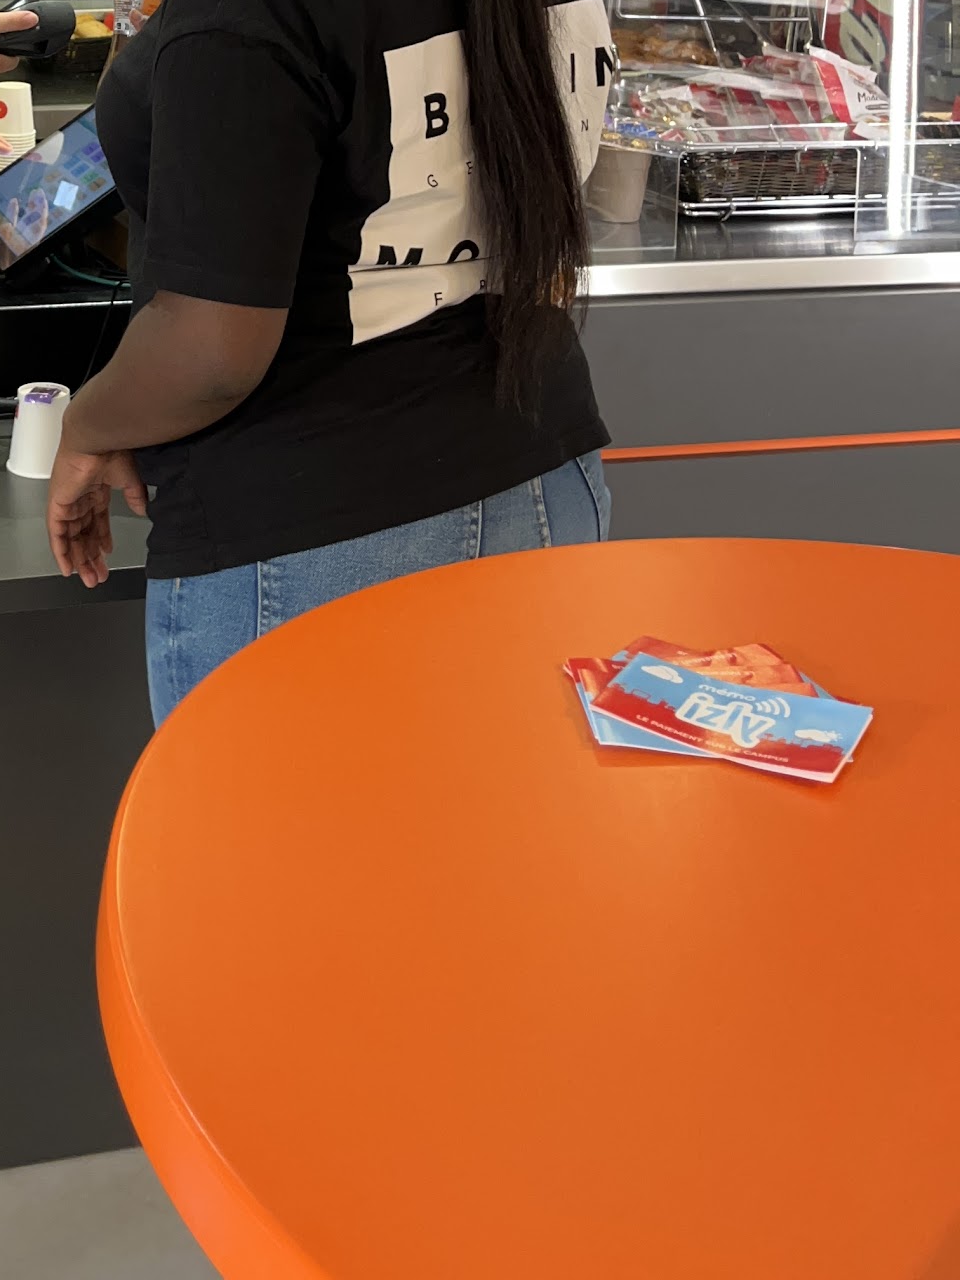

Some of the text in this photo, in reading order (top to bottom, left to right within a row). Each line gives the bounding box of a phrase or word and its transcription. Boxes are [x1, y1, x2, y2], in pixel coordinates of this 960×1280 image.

[698, 683, 756, 702] mémo
[635, 714, 789, 763] LE PAIEMENT SUR LE CAMPUS
[677, 693, 775, 748] izly
